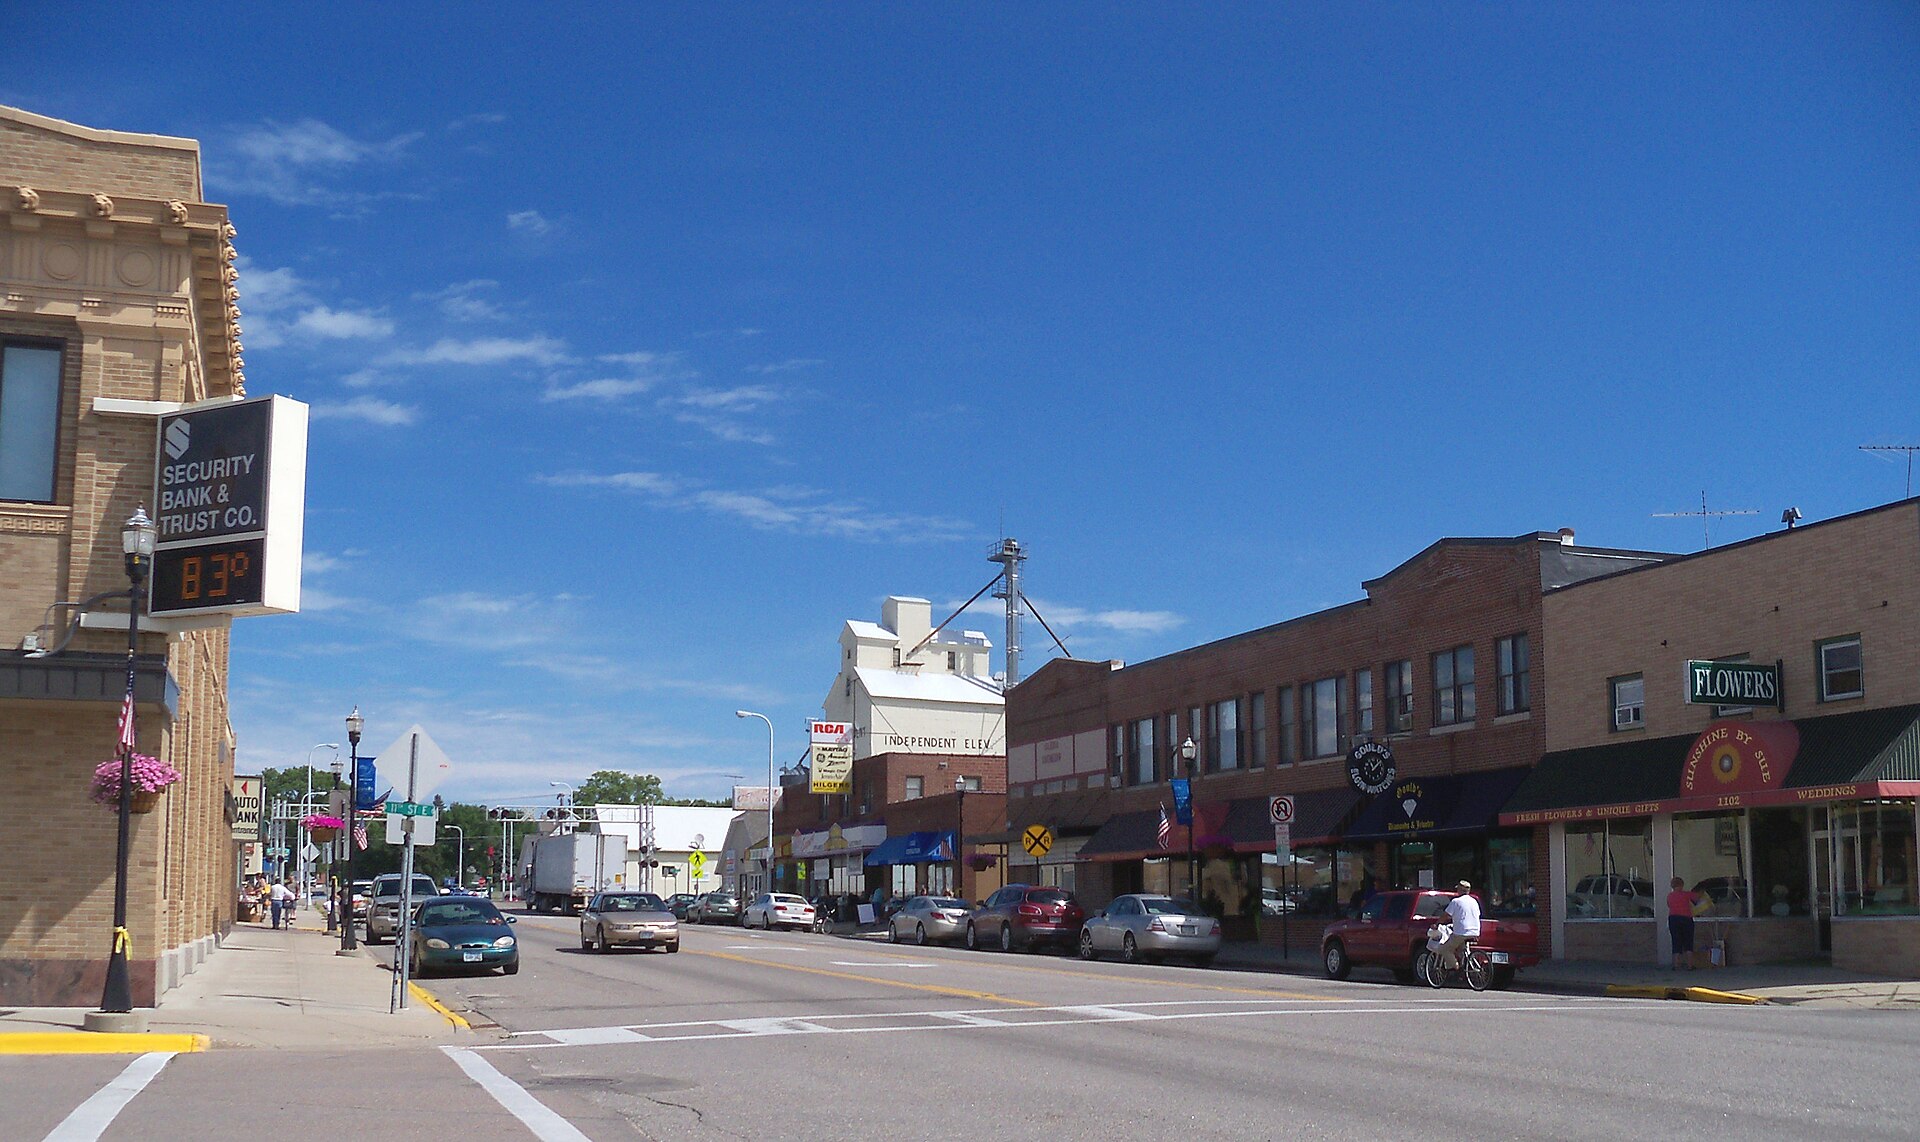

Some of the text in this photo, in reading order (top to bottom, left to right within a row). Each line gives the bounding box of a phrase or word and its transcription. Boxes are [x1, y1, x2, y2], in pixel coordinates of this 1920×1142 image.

[162, 454, 255, 486] SECURITY
[161, 483, 229, 511] BANK &
[160, 505, 257, 535] TRUST CO.
[1694, 668, 1774, 699] FLOWERS
[814, 723, 844, 734] RCA
[884, 735, 957, 748] INDEPENDENT
[1354, 743, 1390, 759] GOULD'S
[1686, 728, 1771, 790] SUNSHINE BY SUE
[1797, 785, 1856, 799] WEDDINGS
[1718, 796, 1740, 807] 1102
[407, 804, 417, 815] ST
[422, 806, 428, 815] E
[1516, 802, 1660, 823] FRESH FLOWERS & UNIQUE GIFTS
[237, 811, 258, 824] ANK
[1025, 836, 1051, 845] R R
